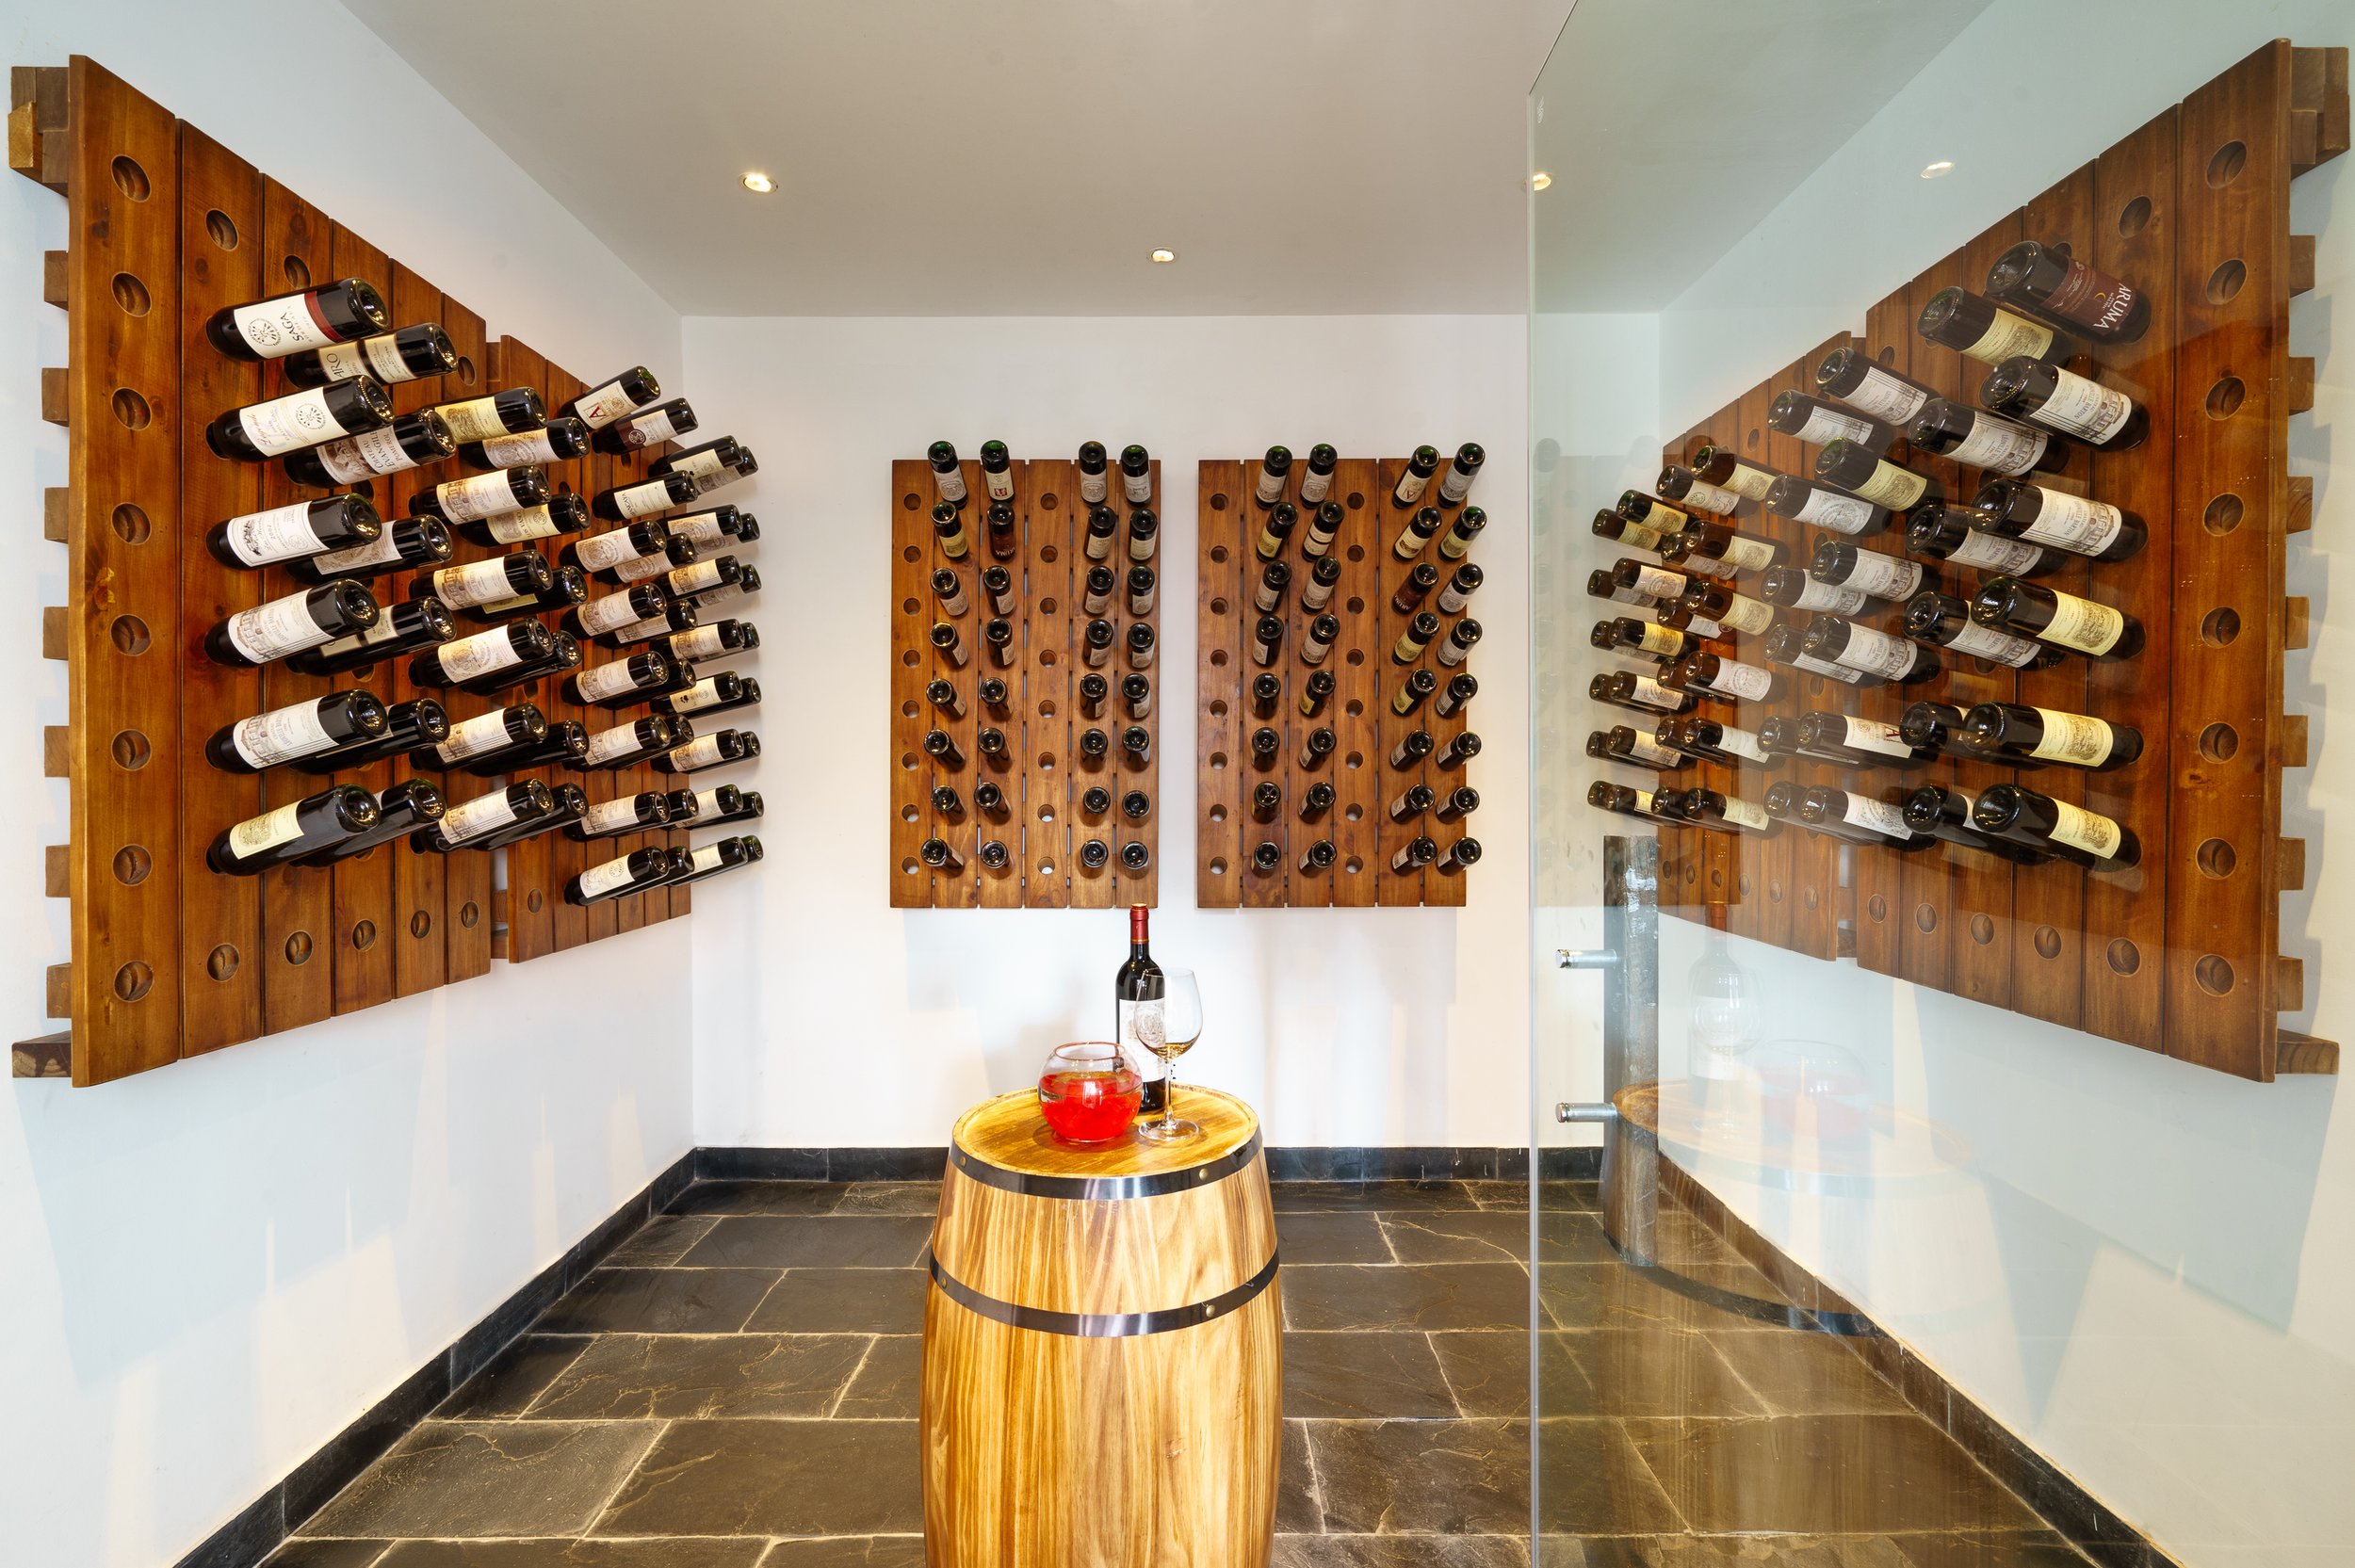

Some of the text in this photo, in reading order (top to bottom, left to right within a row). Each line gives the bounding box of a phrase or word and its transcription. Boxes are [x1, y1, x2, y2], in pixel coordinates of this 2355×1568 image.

[2093, 282, 2132, 330] ARUMA
[280, 312, 304, 341] SAGA
[326, 352, 345, 379] ARO
[2073, 401, 2092, 420] BARTON
[362, 440, 384, 469] CHATEAU
[383, 432, 404, 462] POMEROL
[2063, 519, 2080, 536] BARTON
